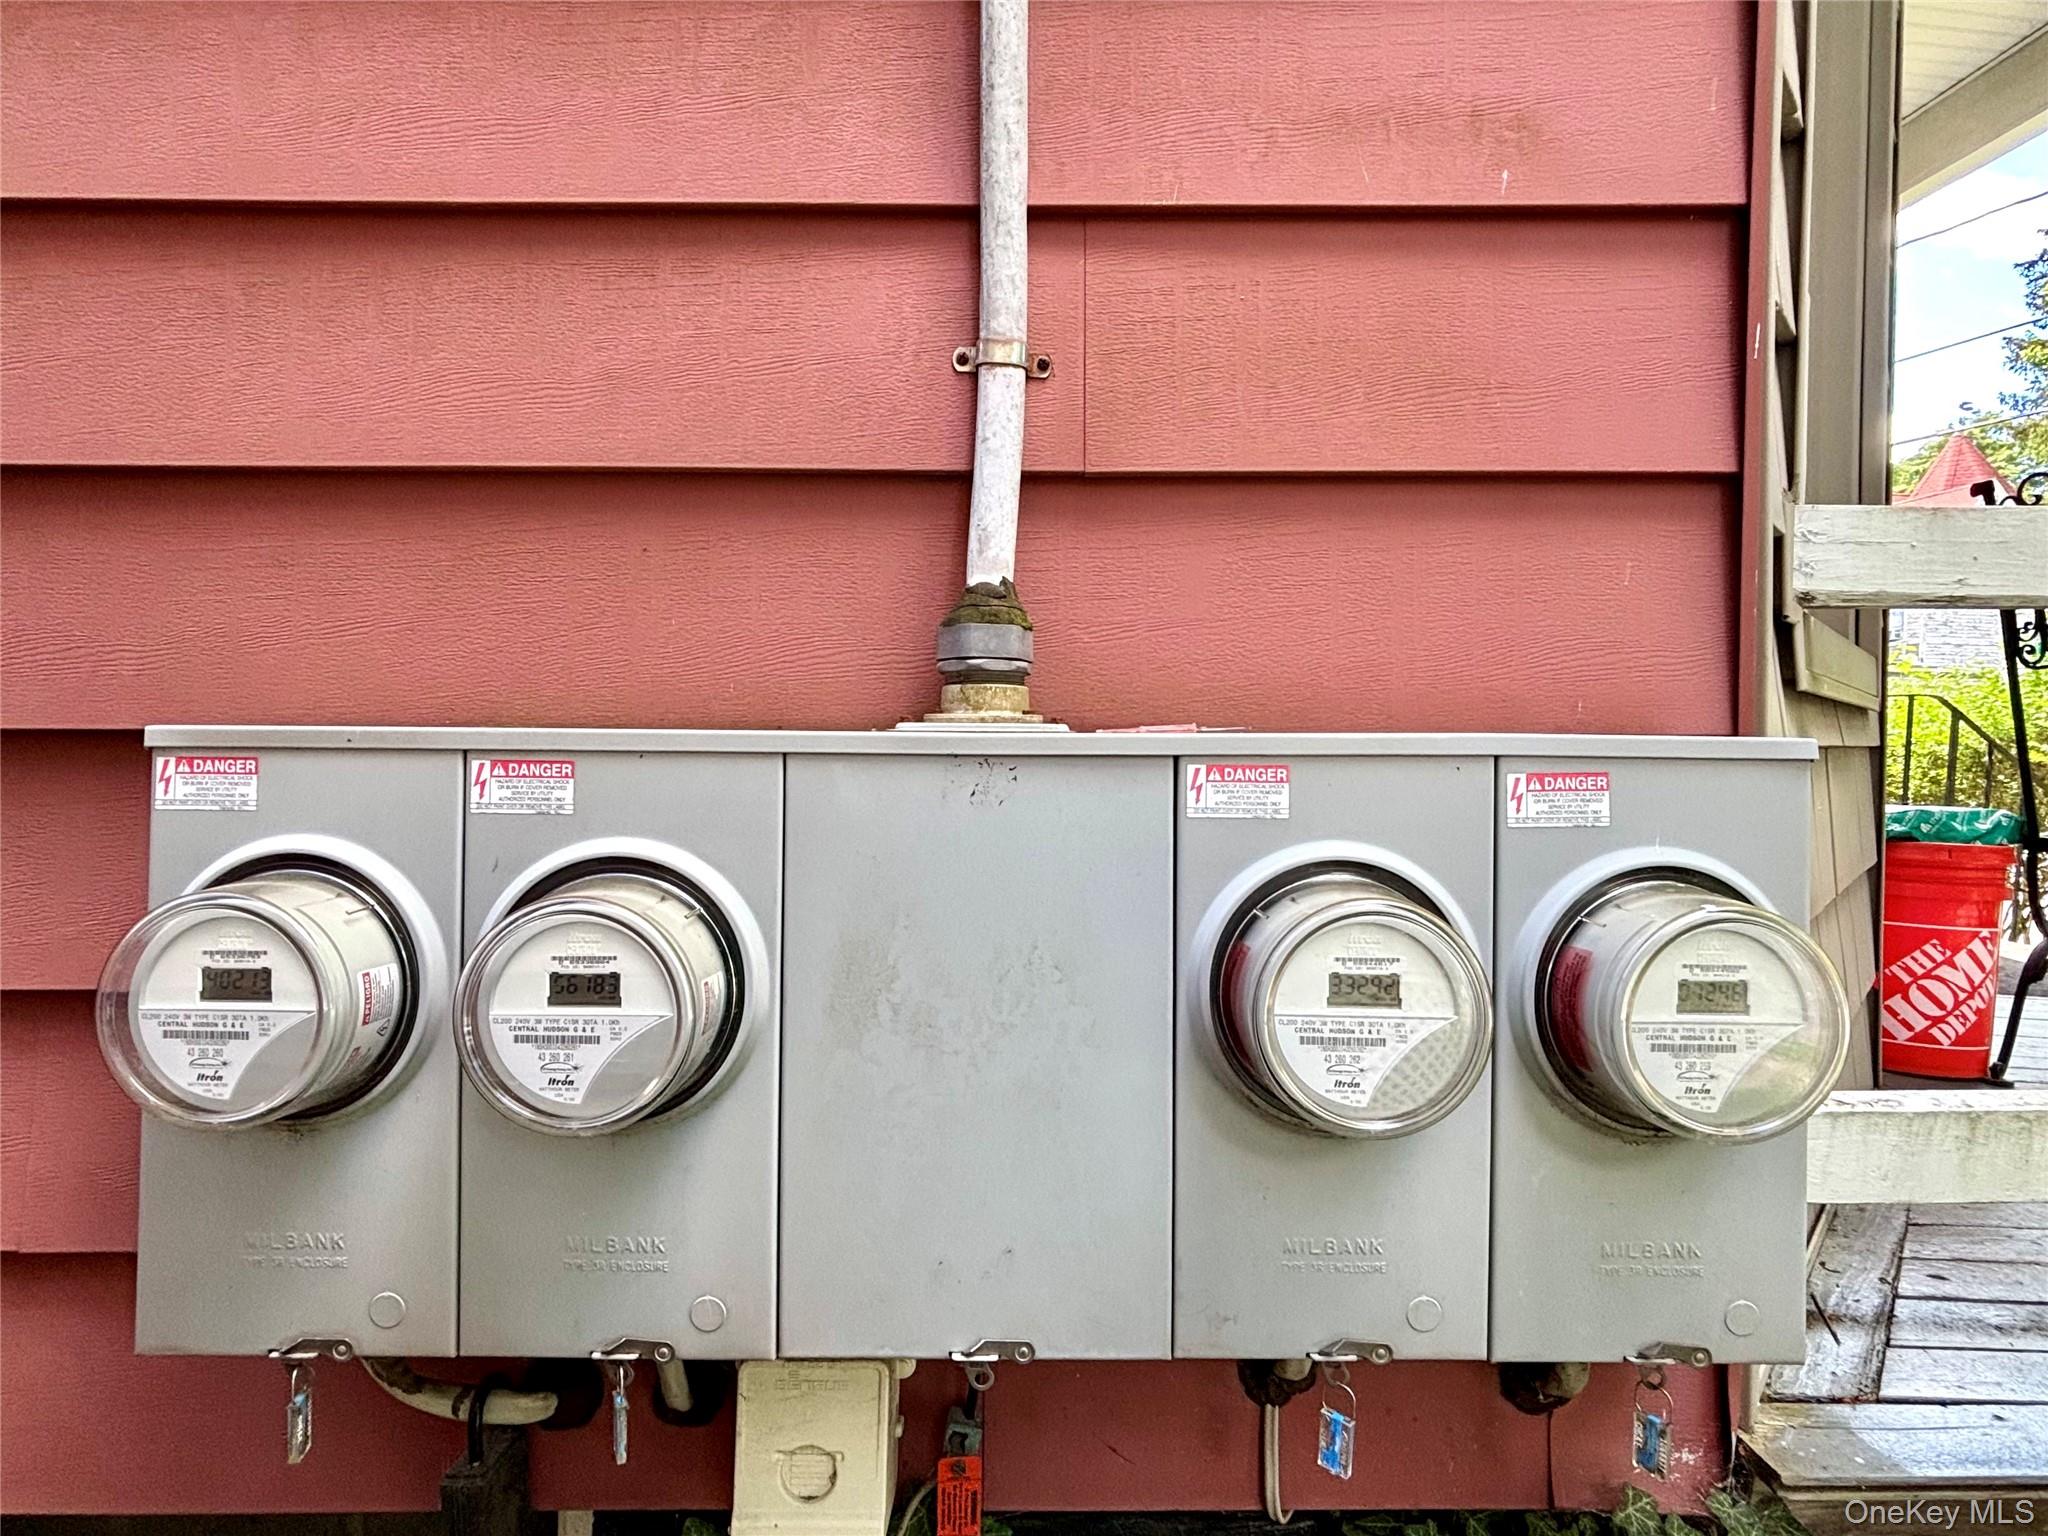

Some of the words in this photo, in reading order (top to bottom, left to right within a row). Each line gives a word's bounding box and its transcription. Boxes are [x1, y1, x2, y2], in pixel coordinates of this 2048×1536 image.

[194, 760, 256, 773] DANGER
[509, 763, 572, 777] DANGER
[1224, 768, 1287, 781] DANGER
[1544, 776, 1608, 790] DANGER
[1884, 939, 1952, 984] THE
[554, 976, 618, 994] 56183
[1882, 930, 1996, 1041] HOME
[363, 975, 372, 1016] PELIGRO
[538, 1052, 545, 1061] 43
[197, 1070, 223, 1081] Itron
[548, 1075, 574, 1086] Itron
[1334, 1077, 1360, 1088] Itron
[1684, 1083, 1711, 1094] Itron
[566, 1236, 666, 1254] MILBANK
[1282, 1238, 1384, 1255] MILBANK
[1601, 1242, 1701, 1259] MILBANK
